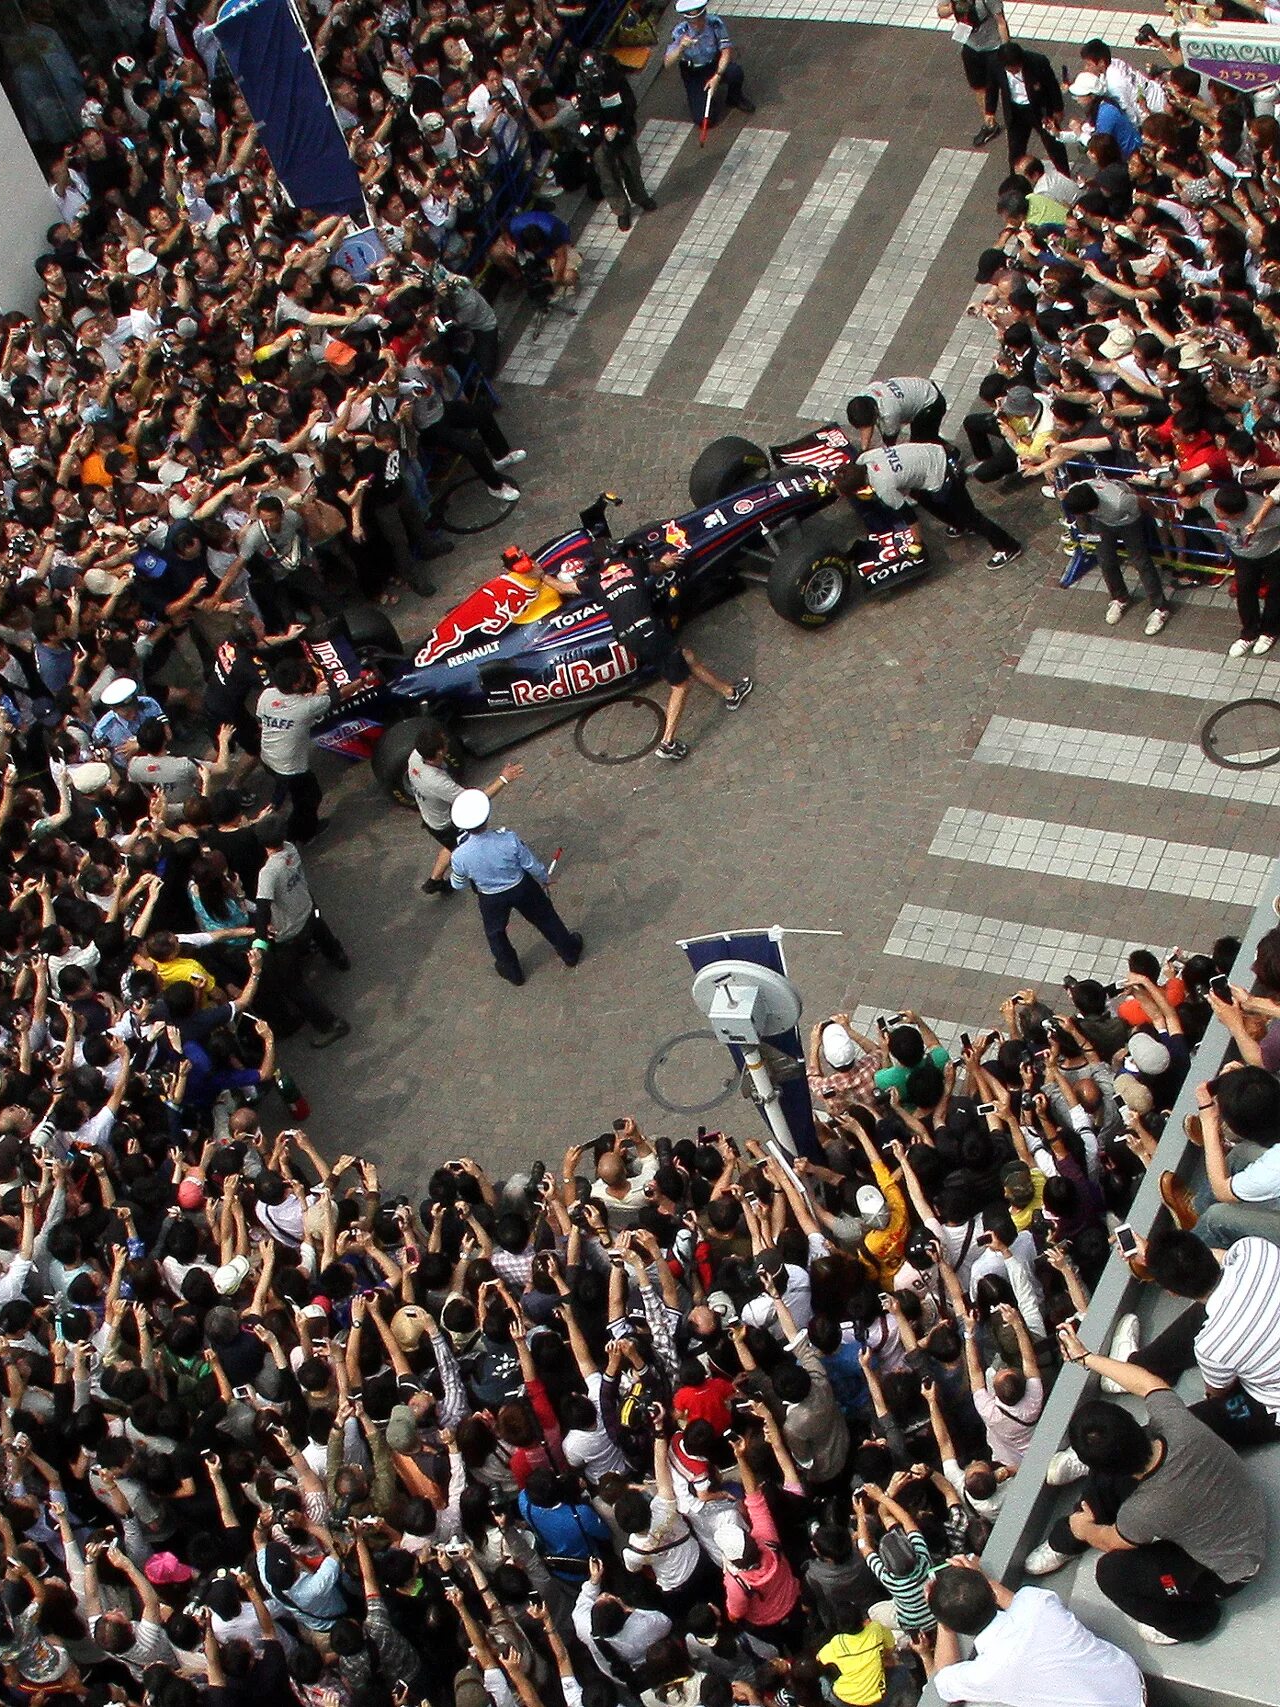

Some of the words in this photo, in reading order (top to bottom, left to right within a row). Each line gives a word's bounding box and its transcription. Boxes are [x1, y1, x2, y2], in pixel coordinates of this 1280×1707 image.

[867, 558, 924, 585] TOTAL
[606, 583, 637, 601] TOTAL
[550, 602, 604, 630] TOTAL
[447, 640, 500, 668] RENAULT
[511, 663, 570, 707] Red
[570, 640, 638, 695] Bull
